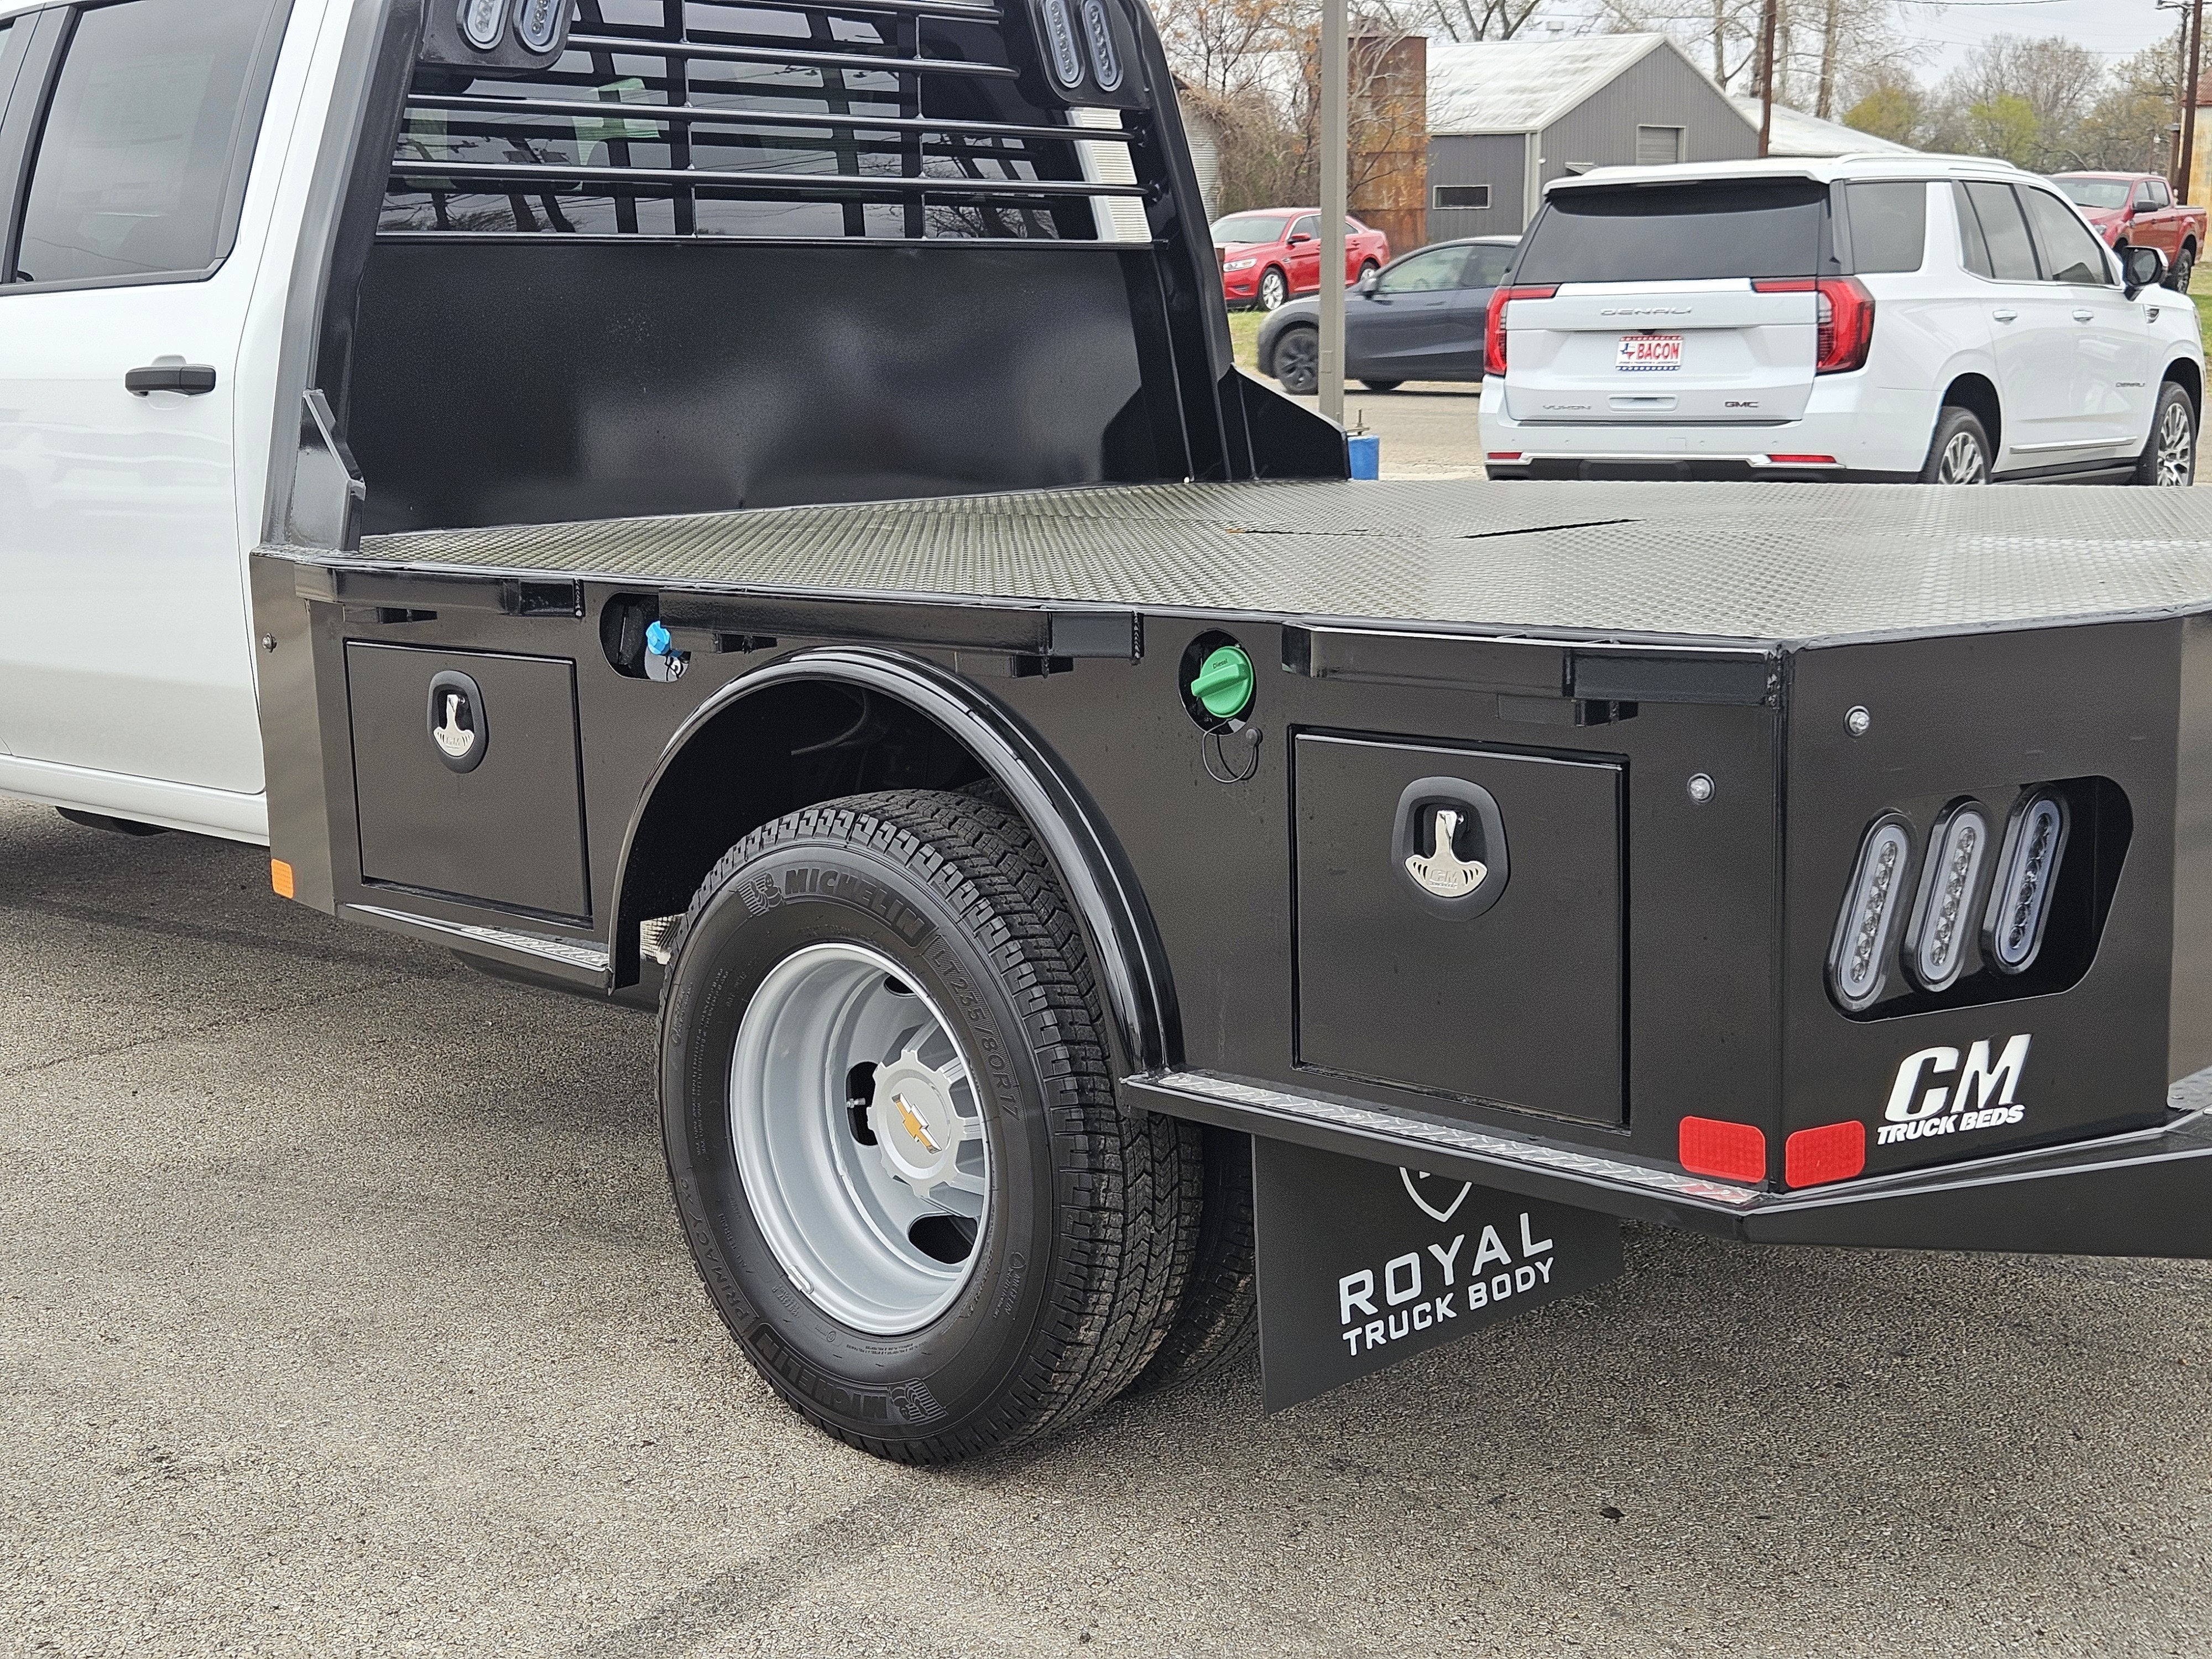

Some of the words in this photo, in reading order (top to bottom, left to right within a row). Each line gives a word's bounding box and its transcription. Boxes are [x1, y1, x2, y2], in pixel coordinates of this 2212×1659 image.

[1600, 307, 1691, 316] DENALI
[1637, 343, 1680, 359] BACON
[785, 868, 925, 939] MICHELIN
[1884, 1033, 2034, 1123] CM
[1877, 1114, 1958, 1145] TRUCK
[1959, 1104, 2026, 1132] BEDS
[1339, 1213, 1553, 1325] ROYAL
[1343, 1293, 1457, 1356] TRUCK
[1468, 1257, 1554, 1311] BODY
[755, 1332, 886, 1419] MICHELIN
